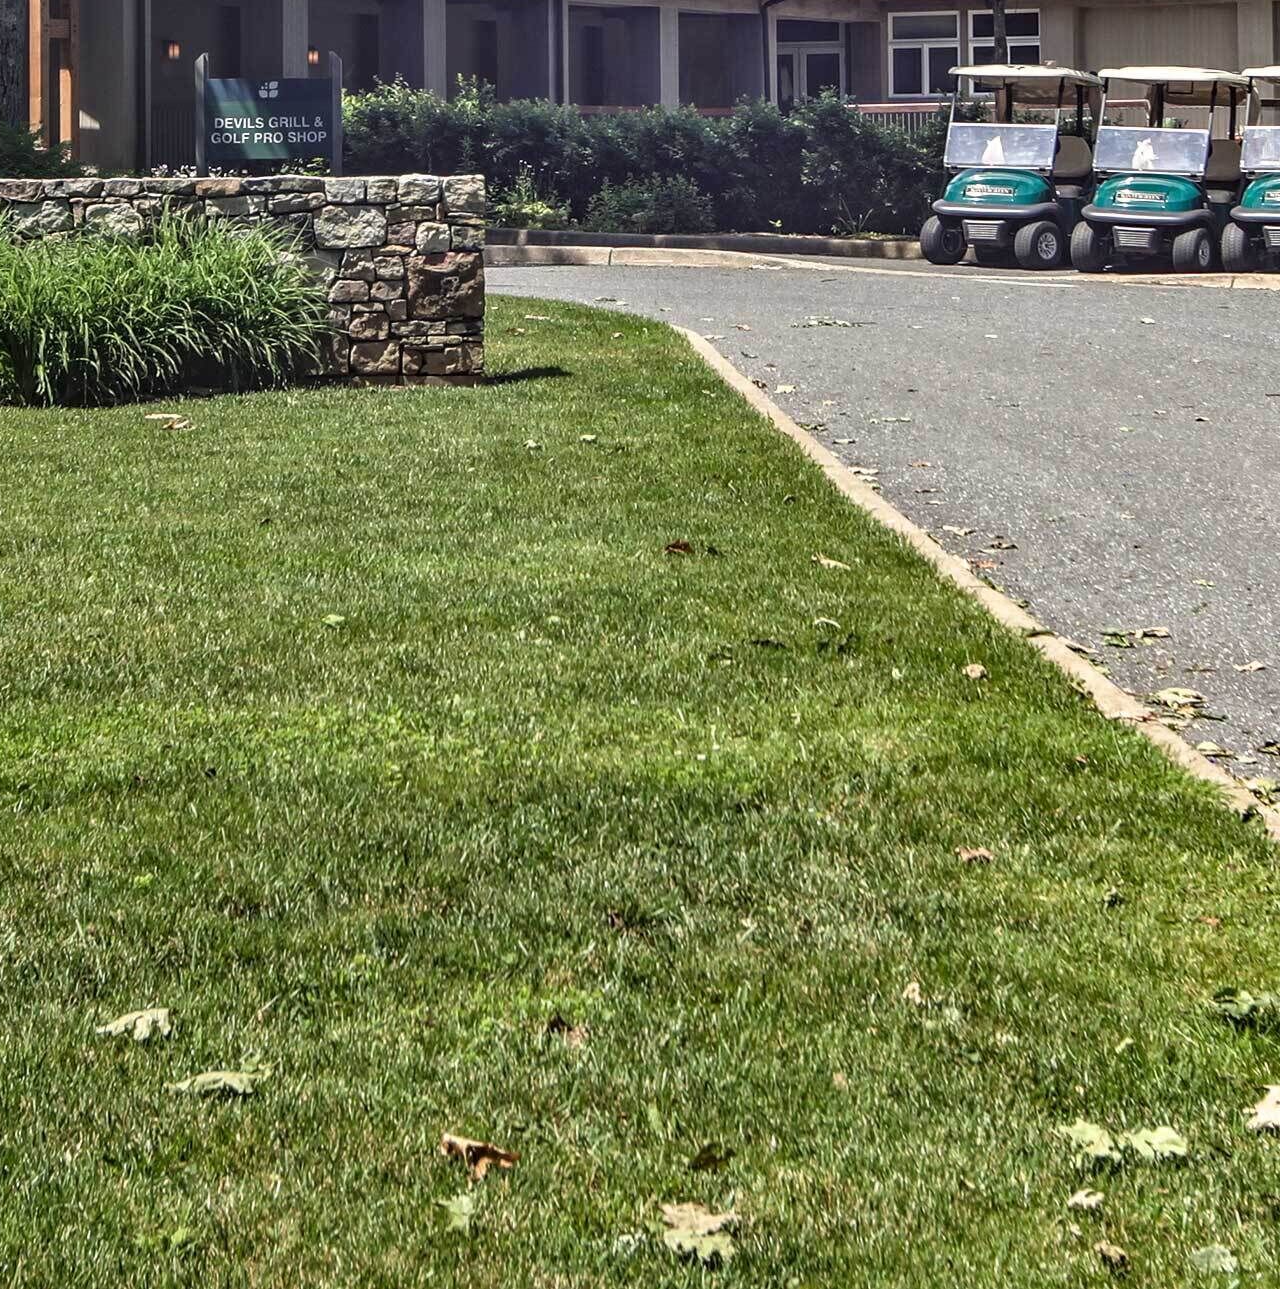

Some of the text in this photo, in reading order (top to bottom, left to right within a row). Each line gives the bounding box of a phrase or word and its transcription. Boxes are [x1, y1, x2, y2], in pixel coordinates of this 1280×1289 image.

[214, 115, 324, 129] DEVILS GRILL &
[210, 131, 328, 144] GOLF PRO SHOP
